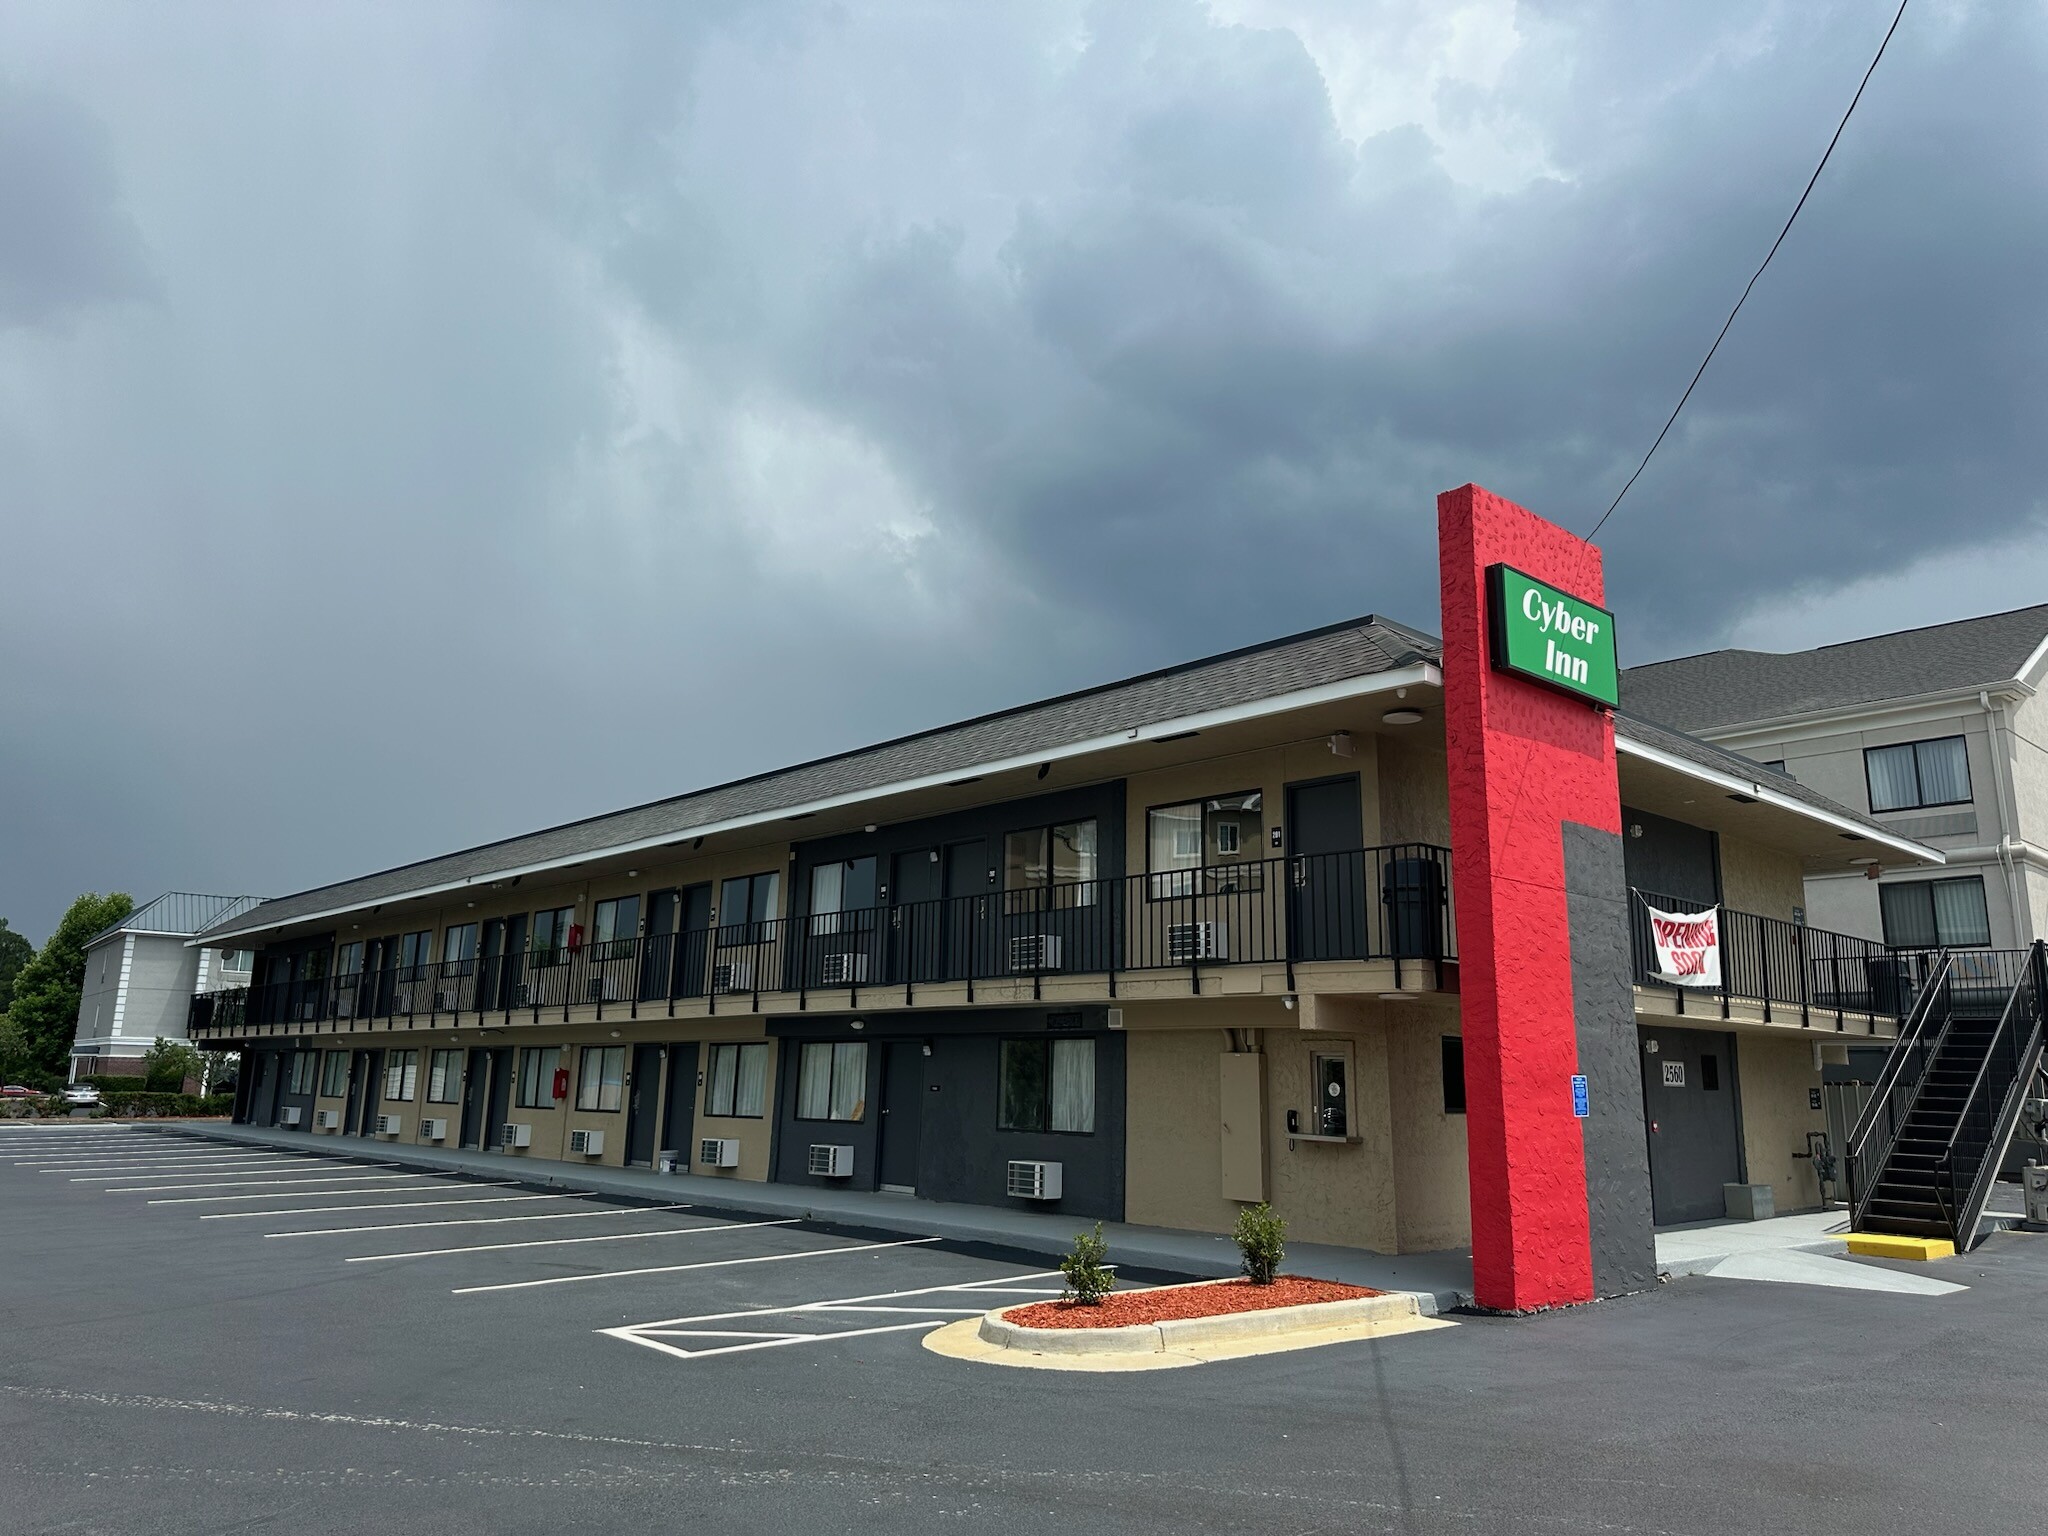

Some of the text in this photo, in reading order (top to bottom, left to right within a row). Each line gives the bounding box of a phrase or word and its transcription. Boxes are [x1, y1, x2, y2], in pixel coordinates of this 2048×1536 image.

[1523, 588, 1599, 645] Cyber
[1545, 638, 1588, 685] Inn
[1653, 918, 1716, 949] OPENING
[1670, 950, 1706, 976] SOON
[1664, 1064, 1683, 1083] 2560
